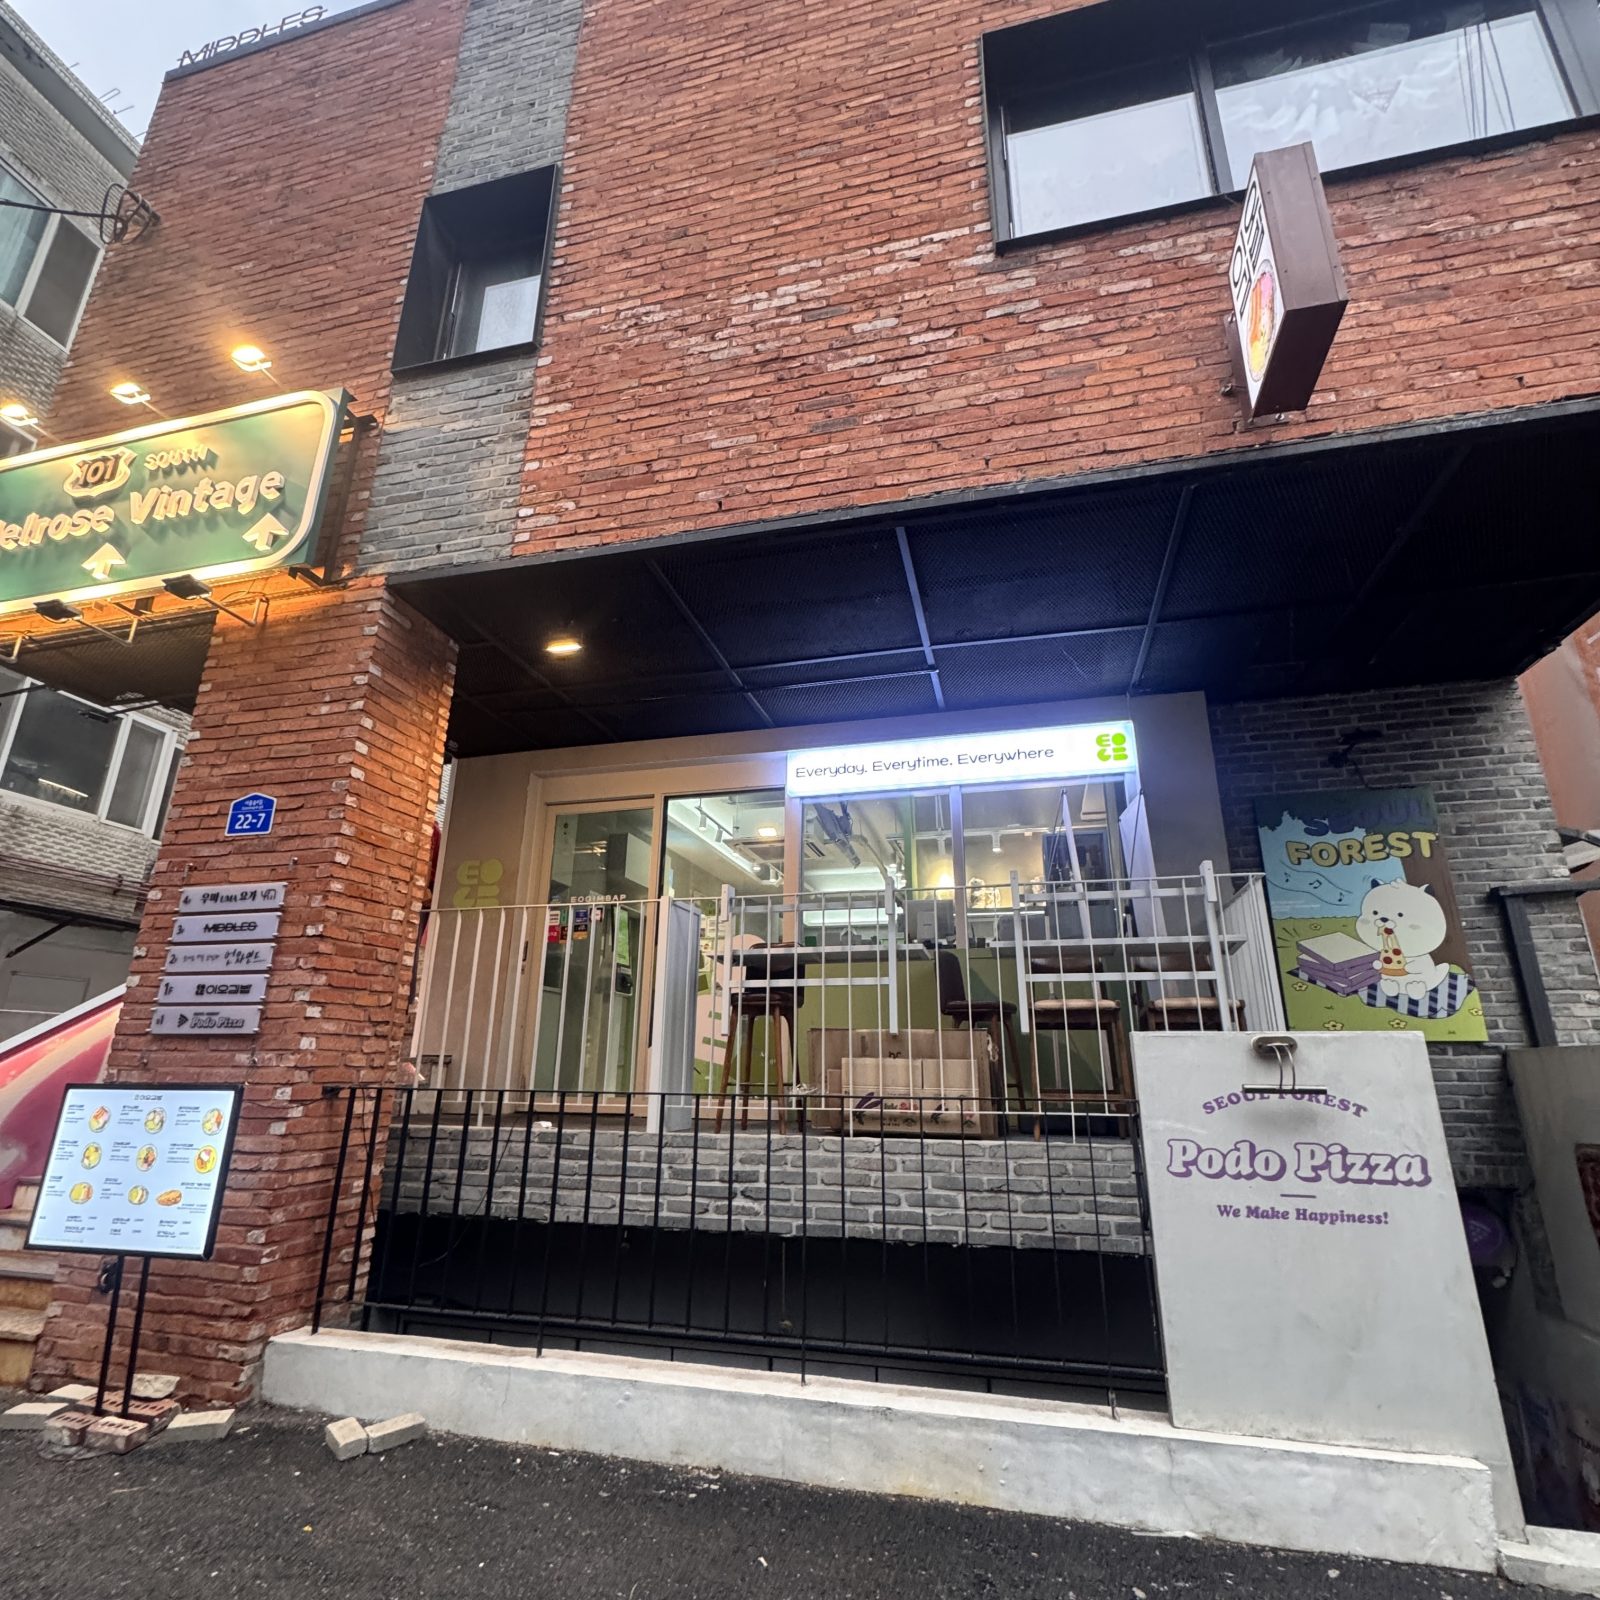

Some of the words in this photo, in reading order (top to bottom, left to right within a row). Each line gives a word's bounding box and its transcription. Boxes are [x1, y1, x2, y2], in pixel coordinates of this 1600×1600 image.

[80, 461, 115, 486] 101
[0, 504, 115, 550] elrose
[130, 471, 285, 522] Vintage
[795, 762, 868, 779] Everyday.
[872, 754, 953, 773] Everytime.
[957, 747, 1055, 765] Everywhere
[234, 812, 266, 830] 22-7
[1285, 831, 1437, 868] FOREST
[206, 984, 252, 995] 이오김밥
[1167, 1138, 1287, 1181] Podo
[1294, 1142, 1432, 1187] Pizza
[1216, 1204, 1241, 1218] We
[1246, 1205, 1290, 1220] Make
[1295, 1208, 1389, 1225] Happiness!
